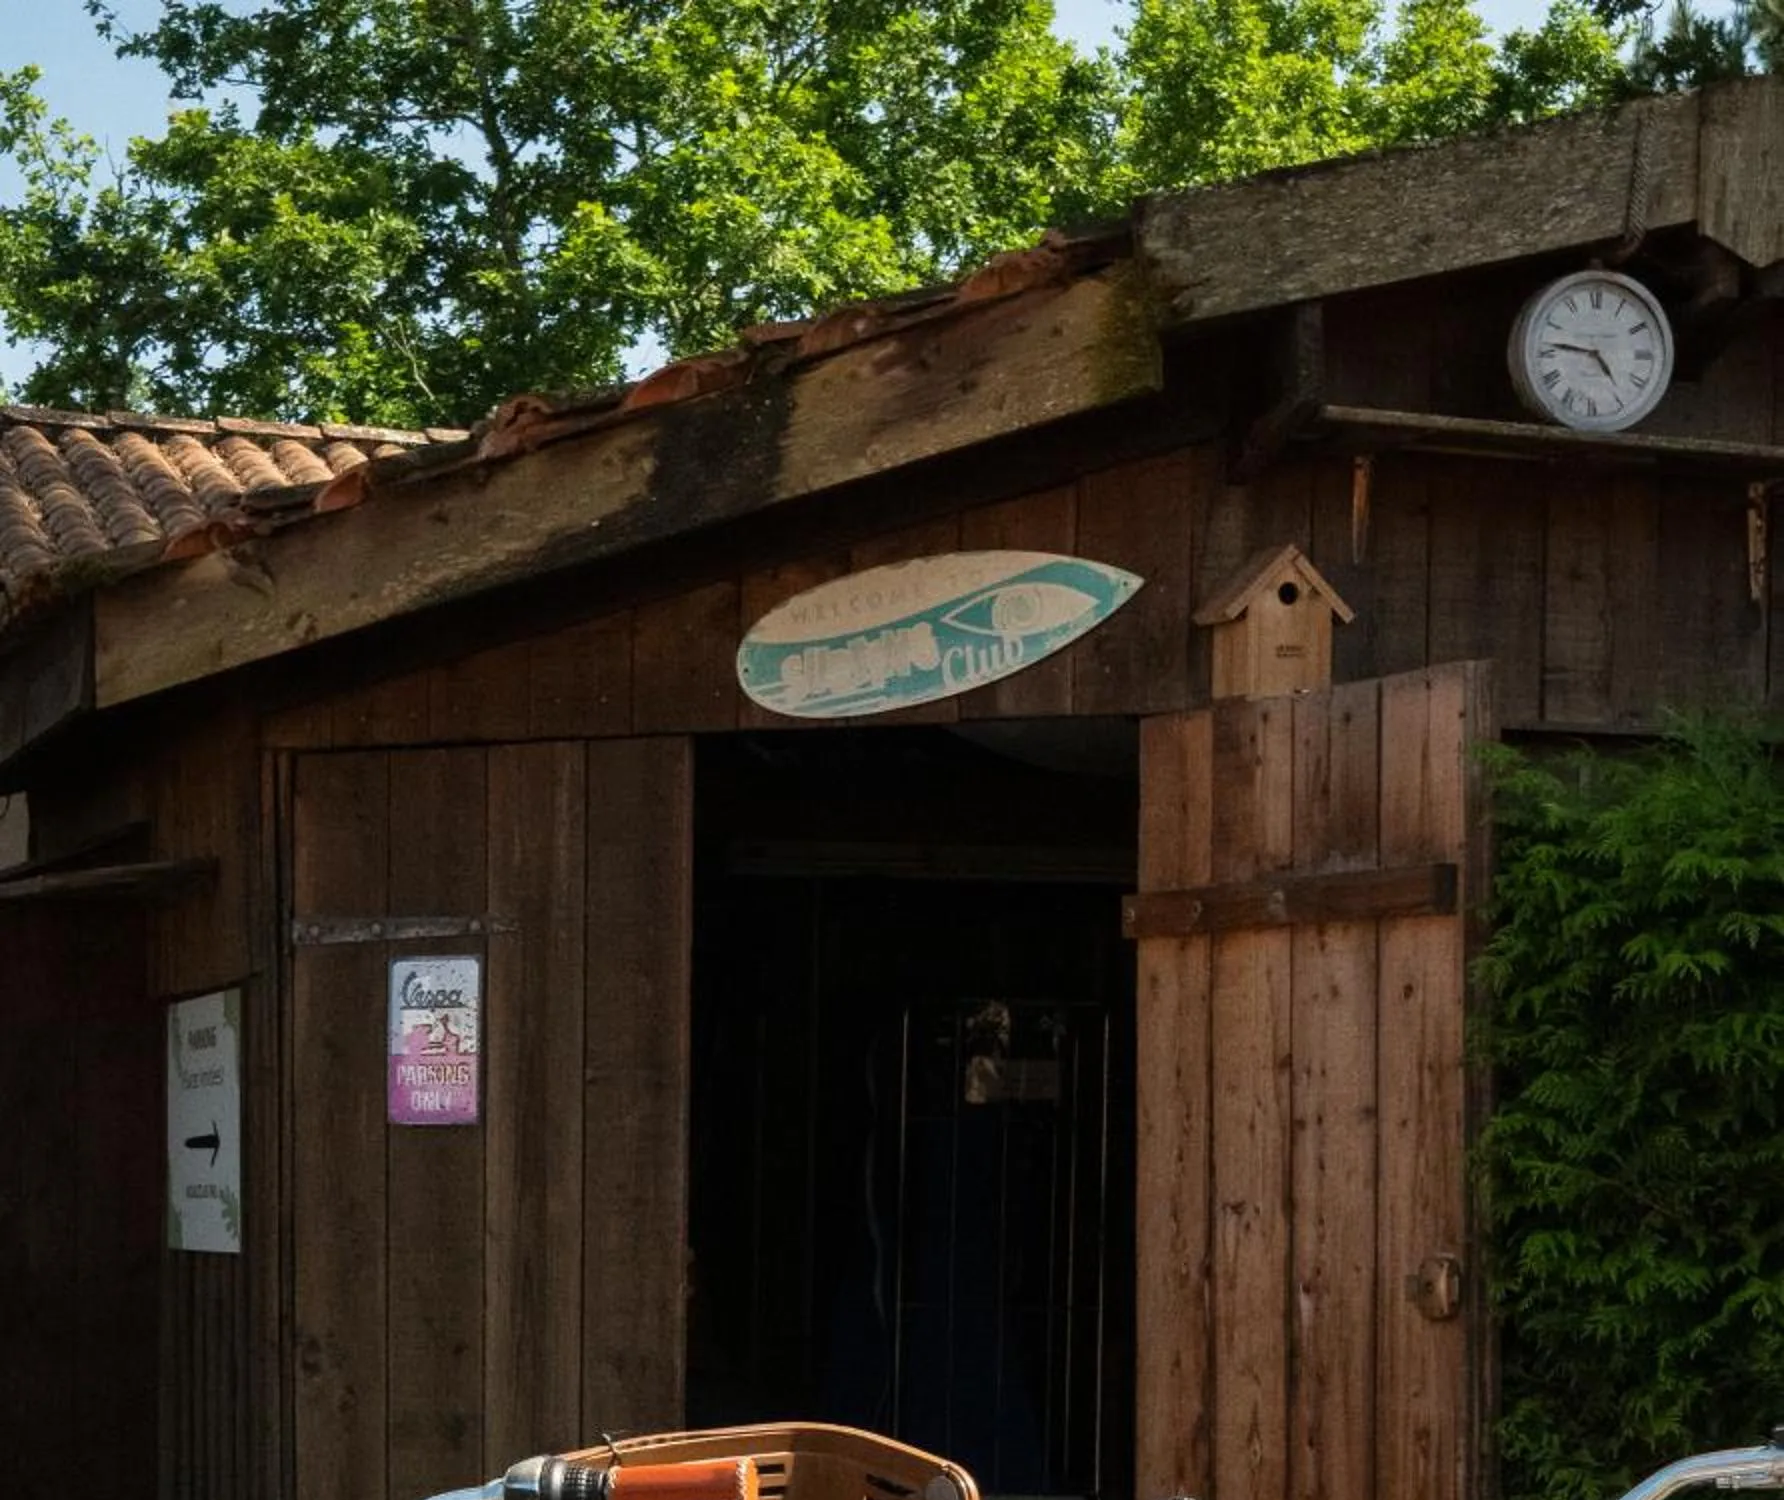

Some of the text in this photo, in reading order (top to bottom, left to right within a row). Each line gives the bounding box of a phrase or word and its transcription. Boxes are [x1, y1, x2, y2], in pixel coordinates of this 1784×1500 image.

[941, 635, 1025, 692] Club
[401, 971, 467, 1011] Vespa
[396, 1062, 470, 1086] PARKING
[410, 1089, 453, 1112] ONLY
